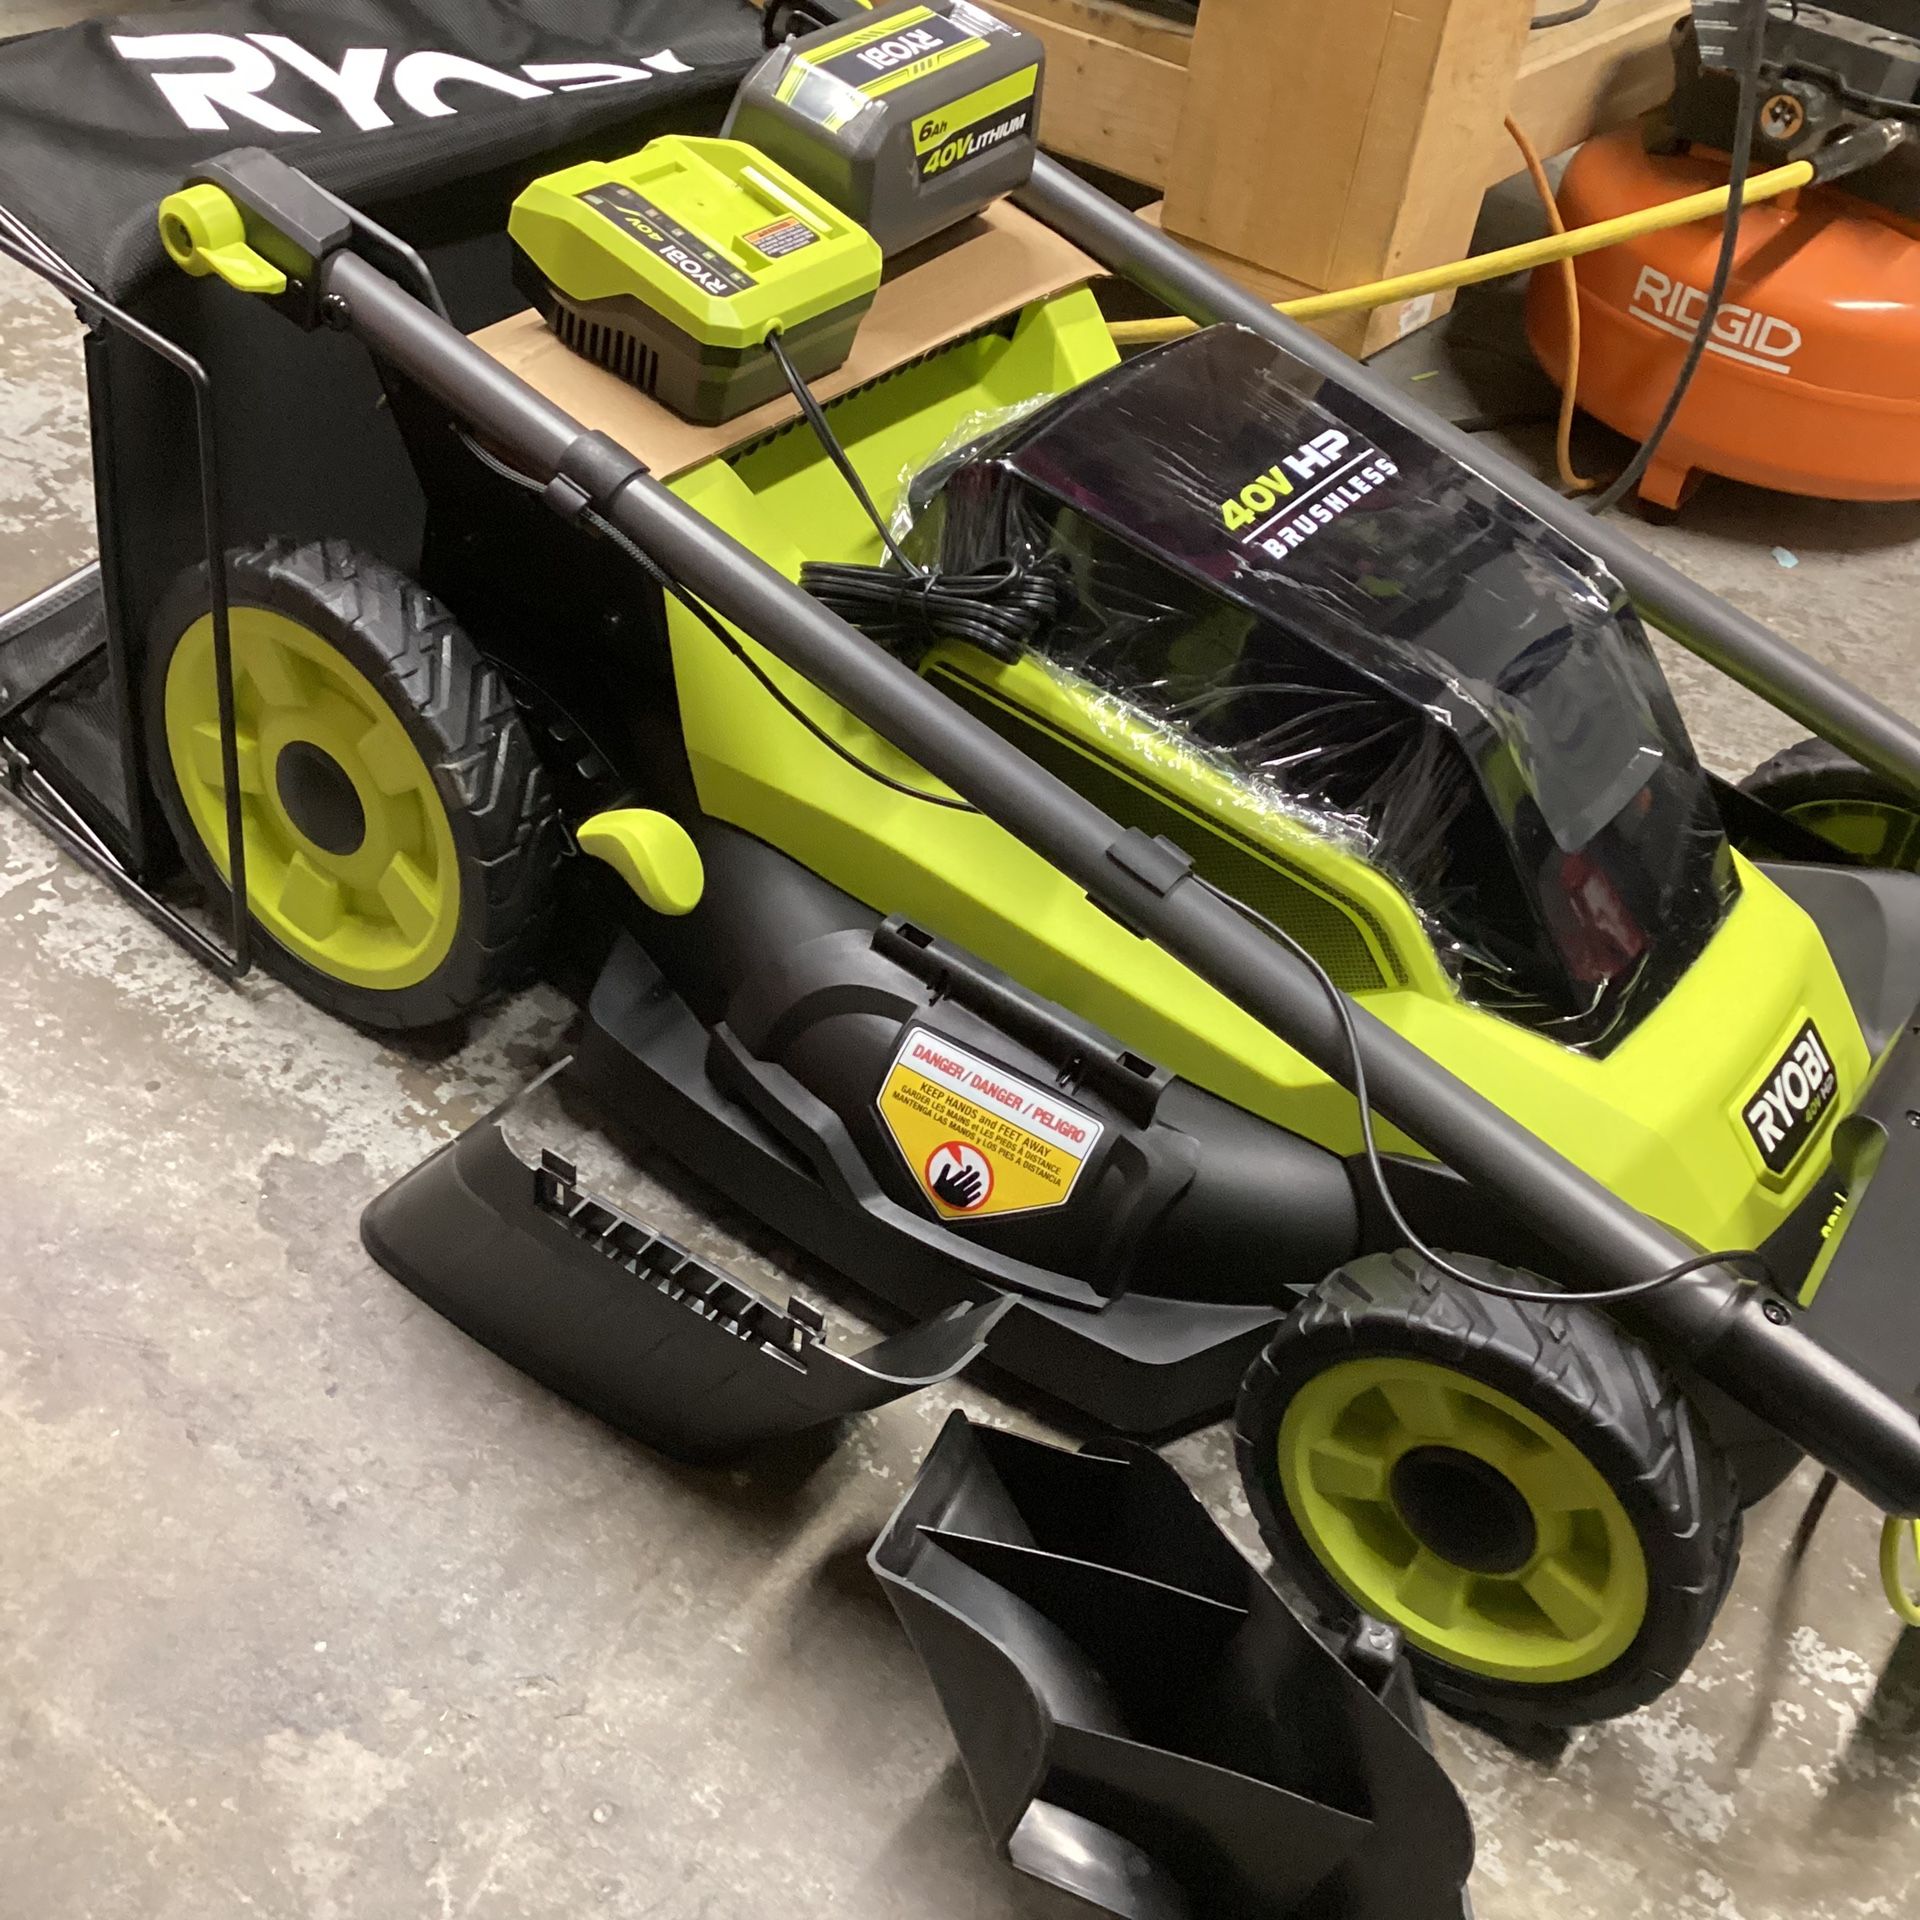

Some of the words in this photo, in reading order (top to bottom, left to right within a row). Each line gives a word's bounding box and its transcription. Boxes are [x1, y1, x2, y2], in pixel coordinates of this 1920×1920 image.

[856, 29, 944, 70] RYOBI
[918, 120, 947, 142] 6Ah
[625, 217, 664, 242] 40V
[658, 245, 728, 295] RYOBI
[1633, 265, 1802, 357] RIDGID
[1221, 464, 1294, 531] 40V
[1282, 429, 1350, 480] HP
[1261, 458, 1399, 560] BRUSHLESS
[901, 1085, 931, 1105] GARDER
[931, 1099, 946, 1112] LES
[946, 1106, 971, 1126] MAINS
[979, 1125, 994, 1139] LES
[995, 1133, 1017, 1152] PIEDS
[1025, 1149, 1062, 1175] DISTANCE
[920, 1082, 945, 1100] KEEP
[946, 1095, 979, 1119] HANDS
[978, 1113, 996, 1129] and
[998, 1124, 1023, 1142] FEET
[1022, 1137, 1051, 1157] AWAY
[970, 1074, 1024, 1110] DANGER
[1032, 1107, 1086, 1144] PELIGRO
[1748, 1029, 1830, 1153] RYOBI
[892, 1091, 932, 1117] MANTENGA
[933, 1111, 948, 1125] LAS
[948, 1118, 976, 1140] MANOS
[982, 1138, 997, 1151] LOS
[997, 1147, 1015, 1161] PIES
[1022, 1160, 1062, 1186] DISTANCIA
